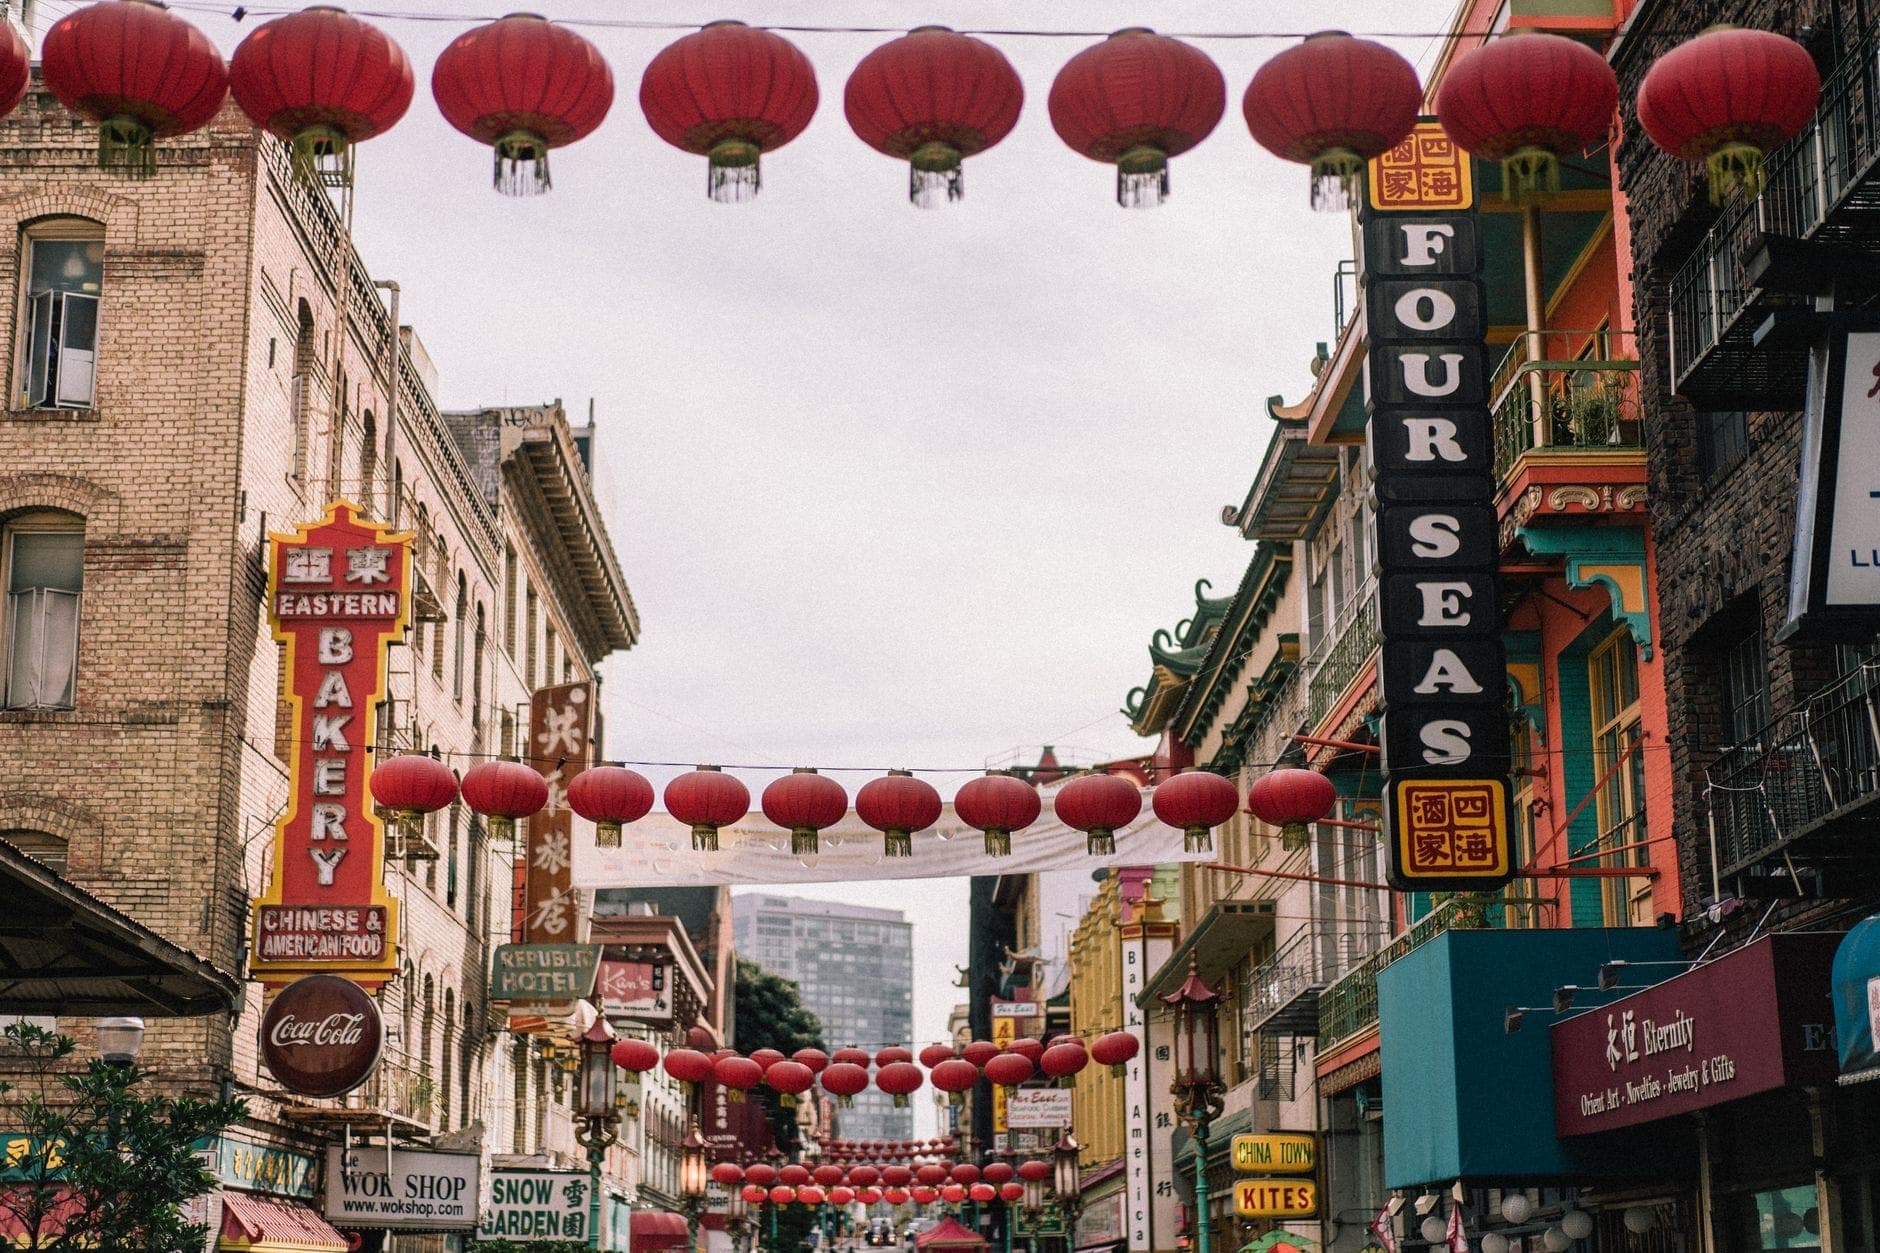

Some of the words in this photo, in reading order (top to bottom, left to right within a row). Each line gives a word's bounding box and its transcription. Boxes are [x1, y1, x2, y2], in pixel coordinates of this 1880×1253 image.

[1394, 224, 1468, 462] FOUR
[279, 594, 396, 615] EASTERN
[1408, 513, 1484, 765] SEAS
[307, 627, 353, 886] BAKERY
[264, 910, 359, 932] CHINESE
[366, 910, 381, 931] &
[263, 934, 338, 956] AMERICAN
[340, 934, 381, 956] FOOD
[502, 972, 580, 992] HOTEL
[1128, 950, 1138, 1026] Bank
[271, 1013, 365, 1046] Coca-Cola
[1642, 1009, 1695, 1052] Eternity
[1581, 1091, 1605, 1116] Orient
[1607, 1087, 1620, 1110] Art
[1625, 1075, 1661, 1105] Novelties
[1668, 1065, 1699, 1093] Jewelry
[1702, 1059, 1709, 1085] &
[1711, 1054, 1736, 1083] Gifts
[1239, 1142, 1272, 1163] CHINA
[1280, 1142, 1311, 1164] TOWN
[340, 1170, 394, 1197] WOK
[405, 1173, 466, 1200] SHOP
[1131, 1104, 1144, 1241] America
[492, 1178, 554, 1205] SNOW
[1243, 1187, 1309, 1210] KITES
[344, 1199, 463, 1217] www.wokshop.com
[481, 1209, 559, 1236] GARDEN
